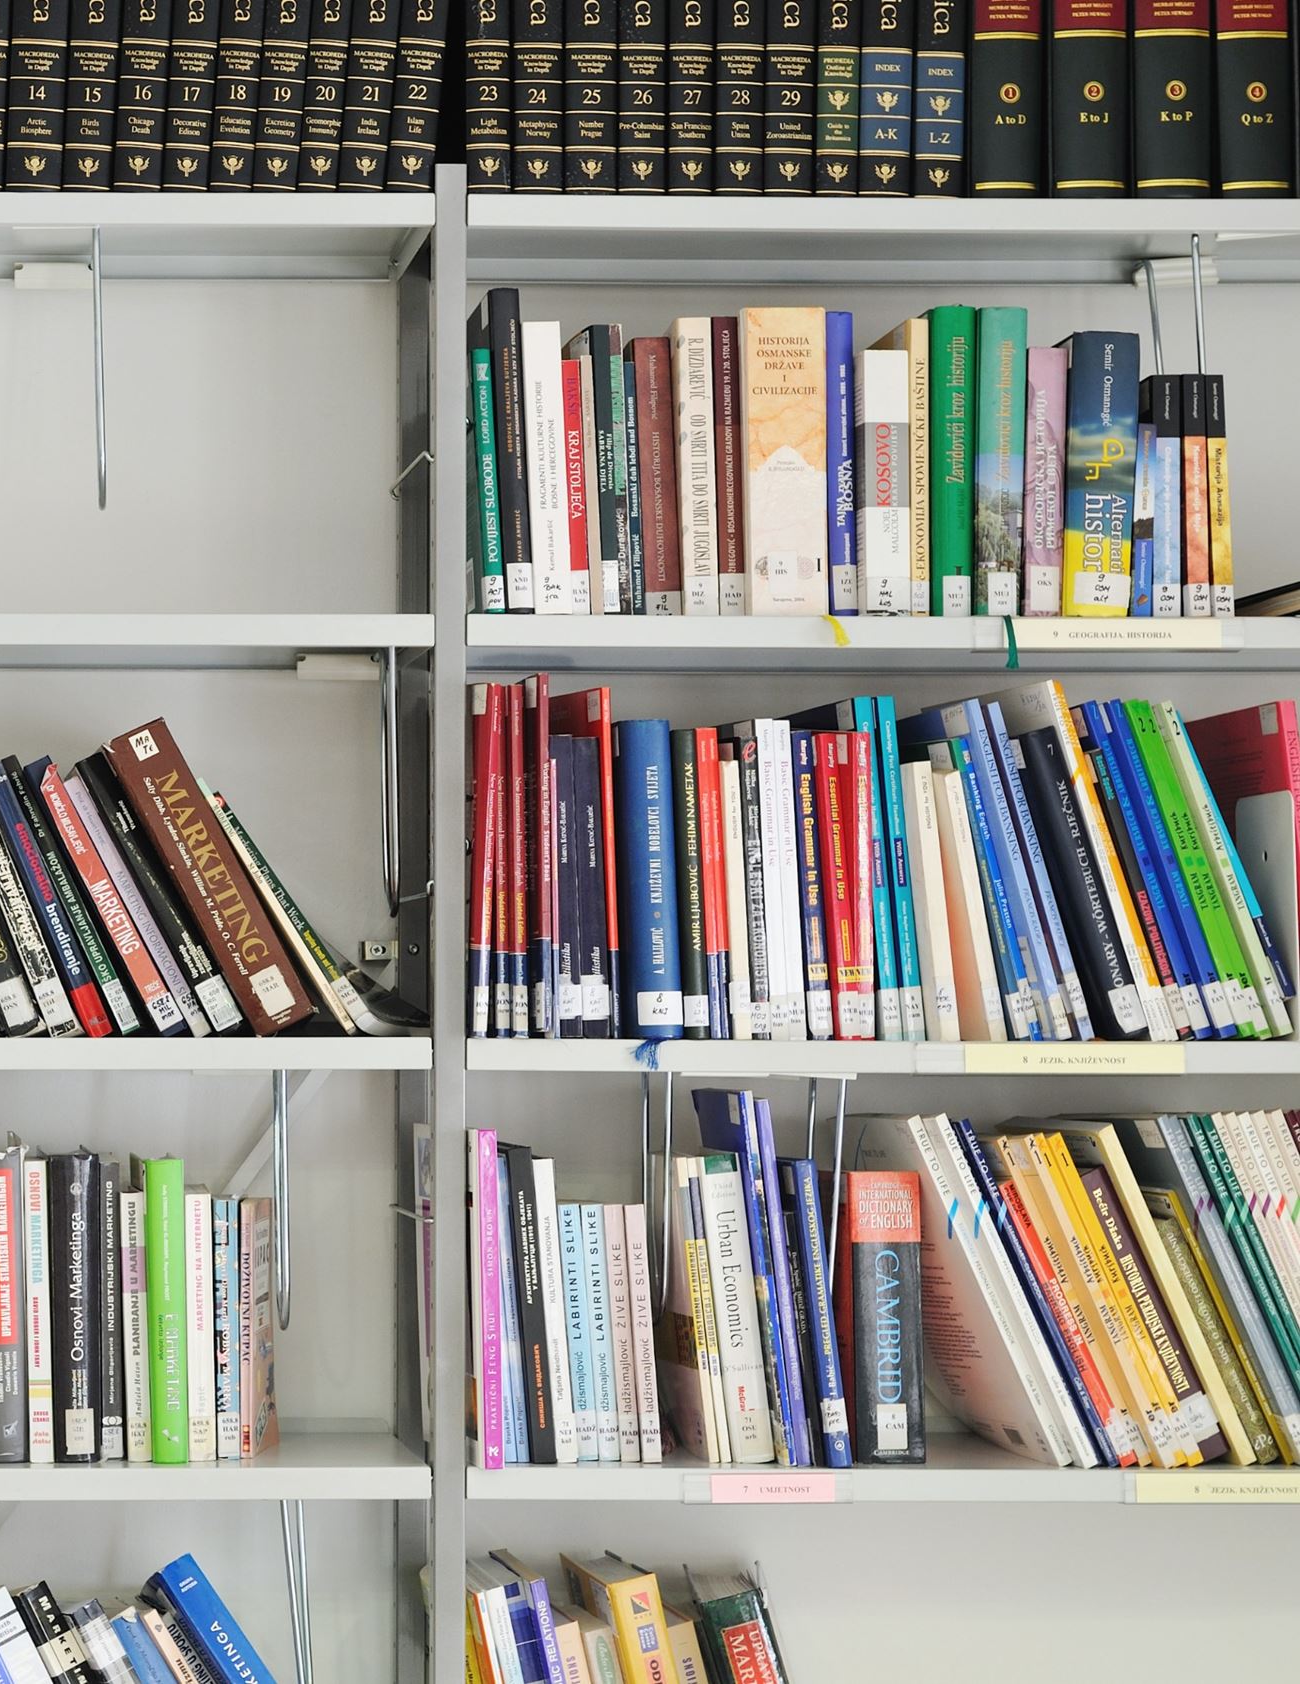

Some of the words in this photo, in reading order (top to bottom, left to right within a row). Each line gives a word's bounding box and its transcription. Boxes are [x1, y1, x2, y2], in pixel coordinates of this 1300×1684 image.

[875, 64, 900, 72] INDEX
[28, 85, 46, 99] 14
[316, 85, 335, 100] 20
[408, 84, 427, 99] 22
[781, 91, 800, 105] 29
[27, 118, 46, 126] Arctic
[82, 119, 99, 127] Birds
[128, 117, 154, 126] Chicago
[220, 116, 251, 126] Education
[1161, 112, 1169, 121] K
[1172, 112, 1181, 121] to
[1185, 112, 1192, 121] P
[21, 126, 52, 136] Biosphere
[81, 127, 99, 135] Chess
[131, 125, 150, 133] Death
[221, 125, 250, 134] Evolution
[579, 120, 604, 128] Number
[581, 129, 602, 137] Prague
[875, 128, 898, 140] A-K
[758, 336, 810, 346] HISTORIJA
[757, 349, 812, 359] OSMANSKE
[1104, 343, 1114, 370] Semir
[764, 360, 805, 370] DRŽAVE
[752, 386, 818, 395] CIVILIZACIJE
[915, 358, 925, 409] BAŠTINE
[1101, 376, 1114, 426] Osmanagić
[568, 430, 580, 461] KRAJ
[913, 410, 925, 494] SPOMENIČKE
[876, 423, 891, 507] KOSOVO
[483, 453, 495, 508] SLOBODE
[569, 462, 584, 519] STOLJEĆA
[486, 509, 499, 563] POVIJEST
[1054, 631, 1058, 639] 9
[1126, 631, 1172, 639] HISTORIJA
[646, 765, 659, 800] SVIJETA
[648, 806, 660, 853] NOBELOVCI
[154, 769, 270, 965] MARKETING
[649, 858, 662, 904] KNJIŽEVNI
[45, 903, 81, 976] brendiranje
[1023, 1056, 1028, 1064] 8
[1039, 1056, 1066, 1065] JEZIK.
[1068, 1056, 1126, 1065] KNJIŽEVNOST
[916, 1128, 932, 1153] TRUE
[930, 1157, 939, 1171] TO
[937, 1175, 950, 1196] LIFE
[859, 1190, 912, 1200] INTERNATIONAL
[859, 1201, 913, 1214] DICTIONARY
[859, 1217, 867, 1226] of
[871, 1215, 912, 1229] ENGLISH
[563, 1209, 575, 1253] SLIKE
[716, 1210, 738, 1258] Urban
[70, 1211, 86, 1299] Marketinga
[107, 1251, 115, 1331] INDUSTRIJSKI
[567, 1261, 581, 1340] LABIRINTI
[722, 1264, 749, 1348] Economics
[70, 1307, 84, 1361] Osnovi
[744, 1485, 748, 1493] 7
[760, 1485, 810, 1493] UMJETNOST
